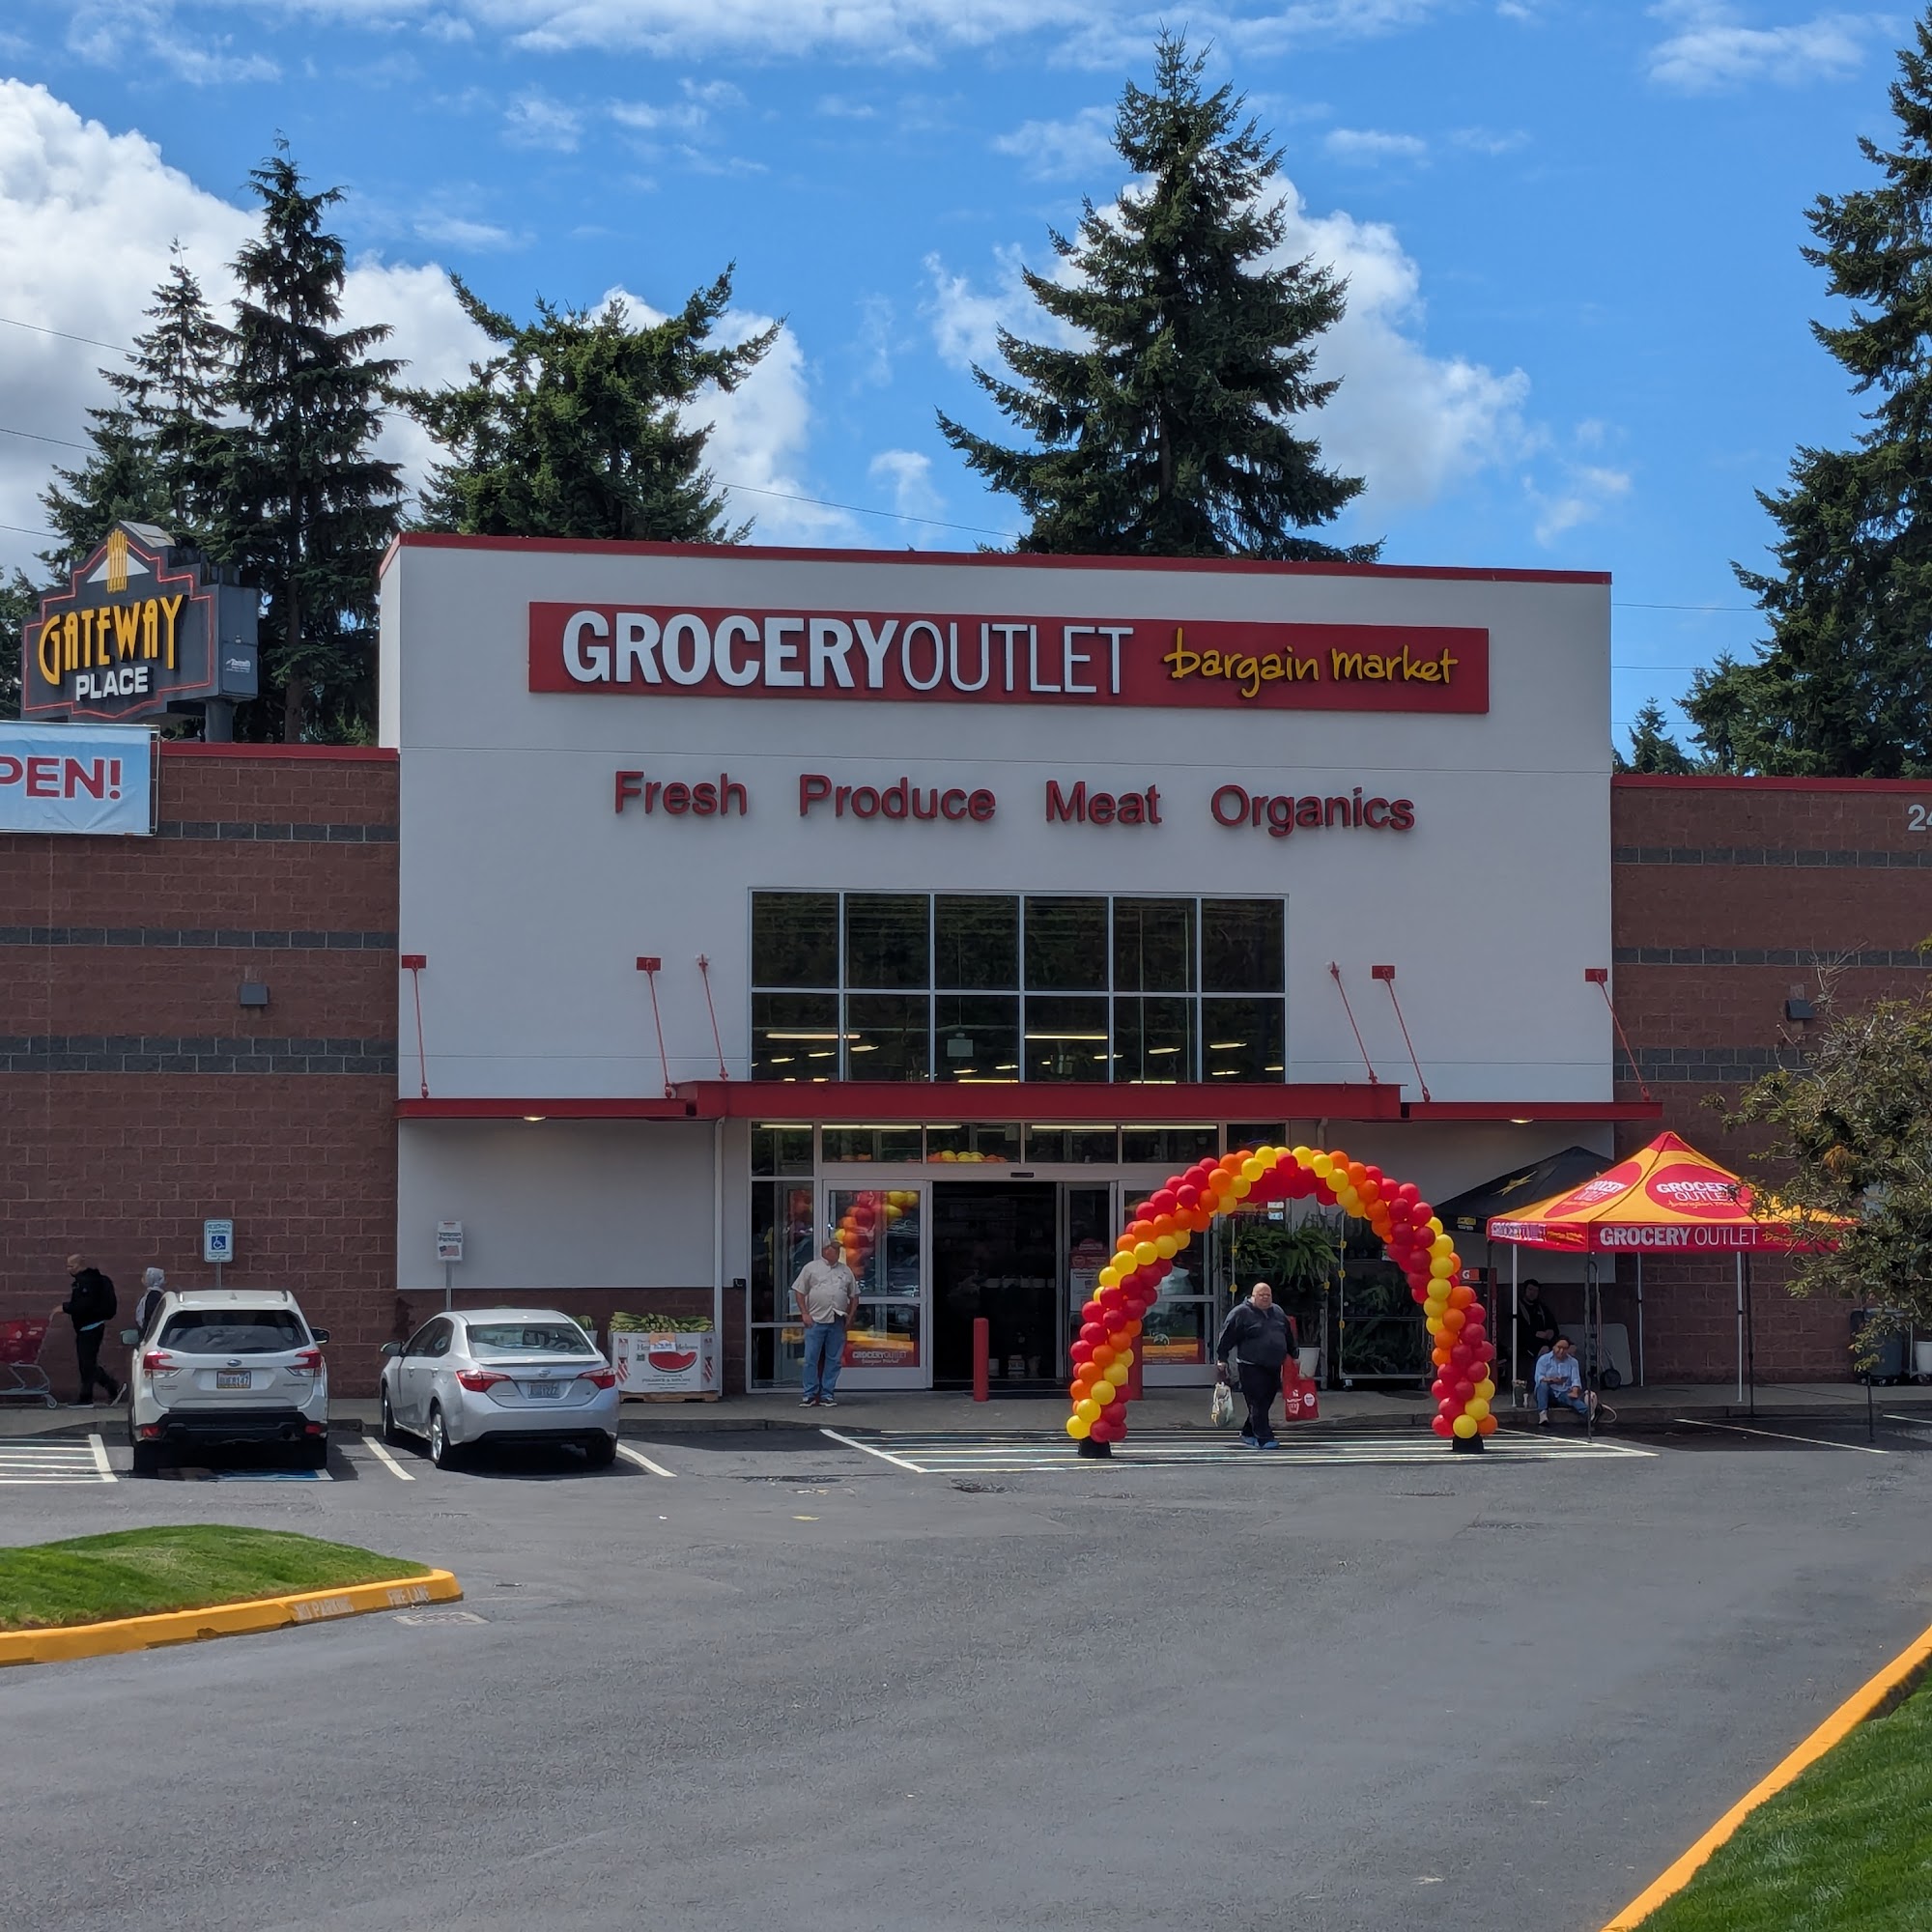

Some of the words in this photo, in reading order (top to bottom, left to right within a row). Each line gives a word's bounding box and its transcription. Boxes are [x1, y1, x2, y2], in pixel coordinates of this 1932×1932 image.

[39, 593, 185, 686] GATEWAY
[1164, 627, 1320, 698] bargain
[1331, 644, 1459, 684] market
[75, 666, 149, 701] PLACE
[614, 770, 748, 815] Fresh
[799, 773, 996, 822] Produce
[1045, 780, 1163, 826] Meat
[1210, 784, 1415, 838] Organics
[1656, 1180, 1733, 1195] GROCER
[1674, 1191, 1735, 1203] OUTLE
[1599, 1225, 1691, 1247] GROCERY
[1694, 1226, 1760, 1247] OUTLET
